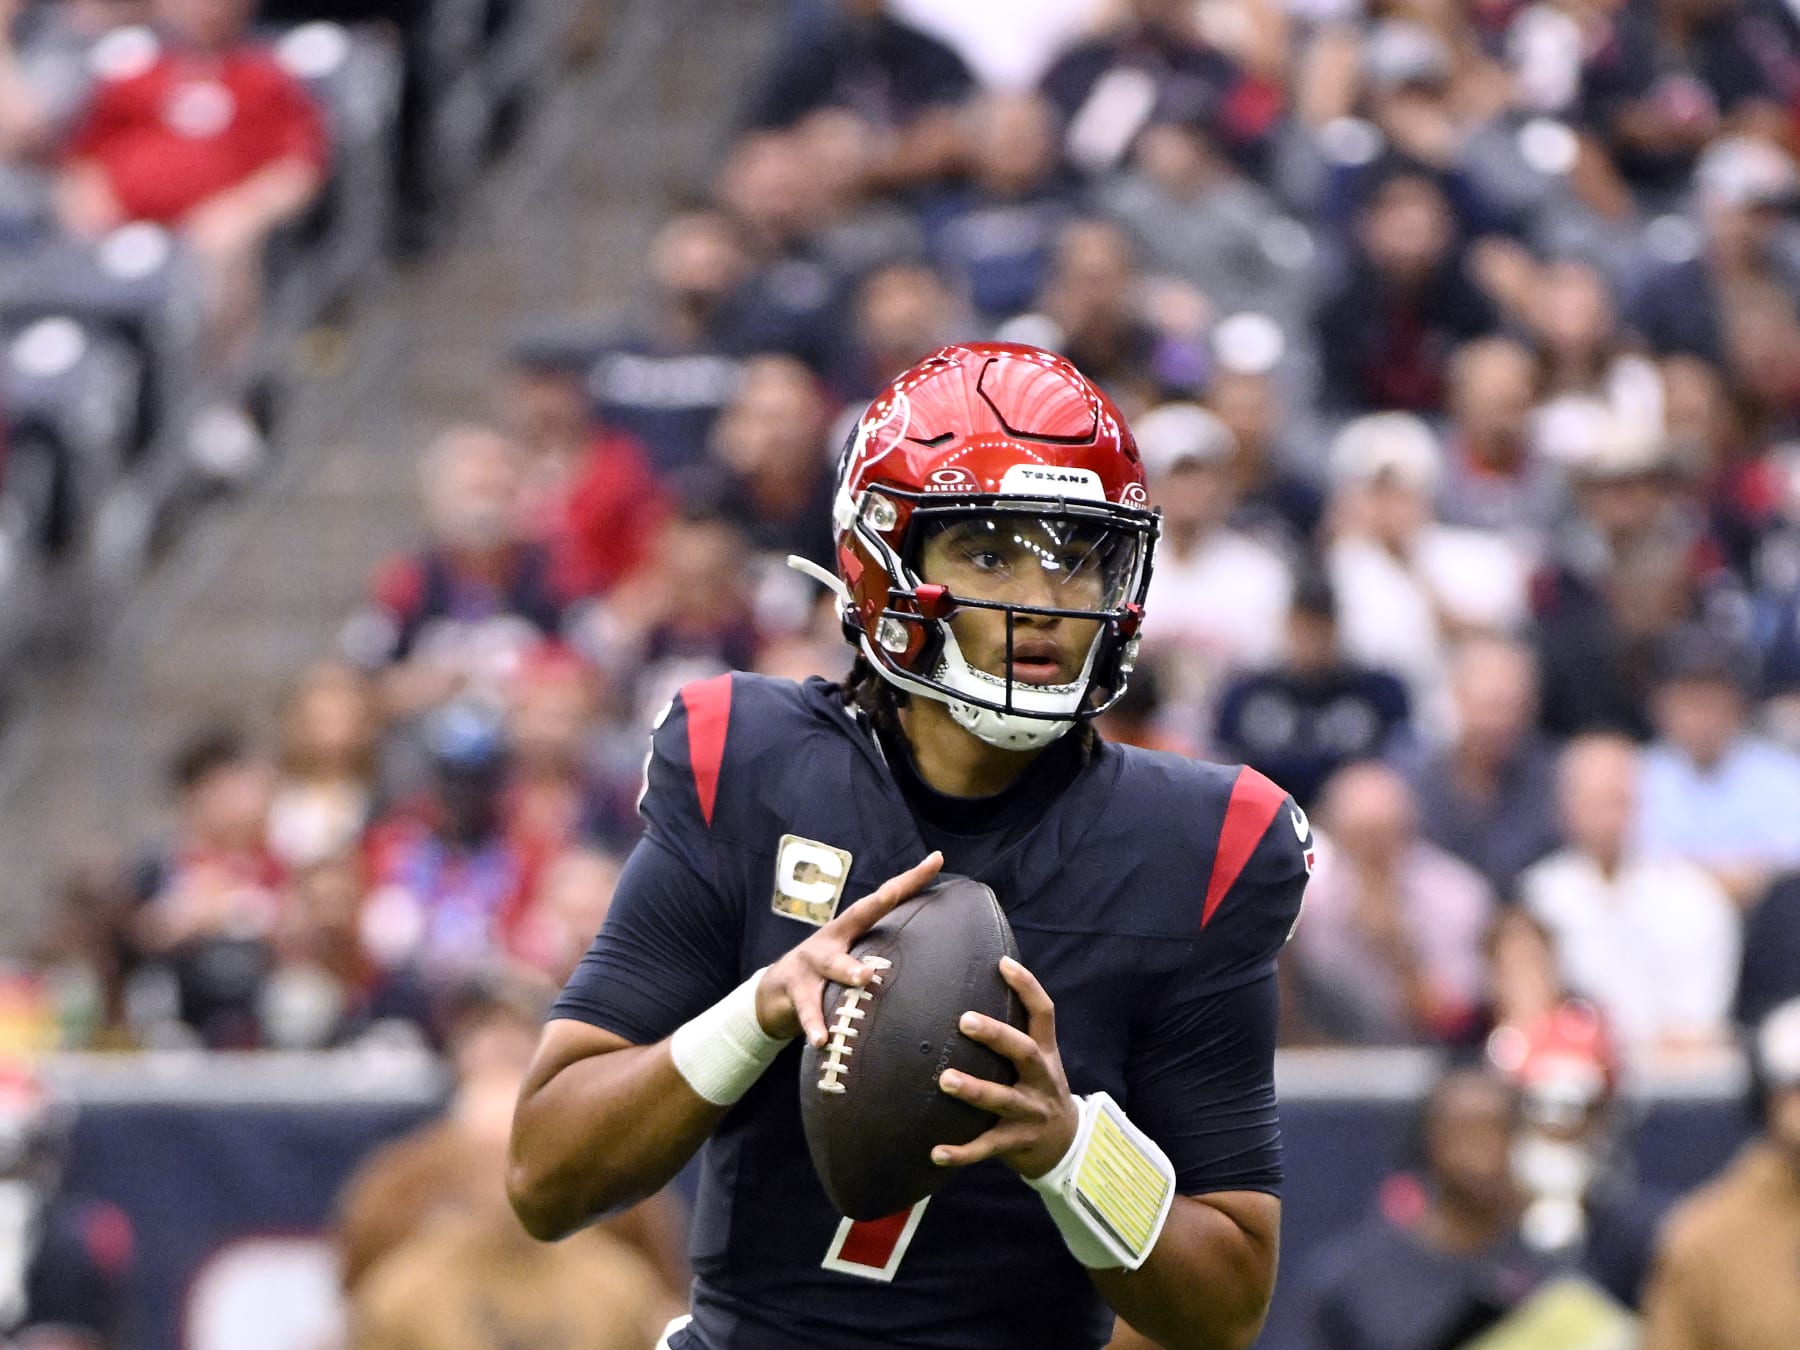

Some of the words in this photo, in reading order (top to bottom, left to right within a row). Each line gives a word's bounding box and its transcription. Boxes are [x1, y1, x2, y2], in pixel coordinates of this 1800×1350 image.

[1021, 470, 1089, 484] TEXANS
[924, 484, 976, 492] OAKLEY
[778, 842, 843, 904] C
